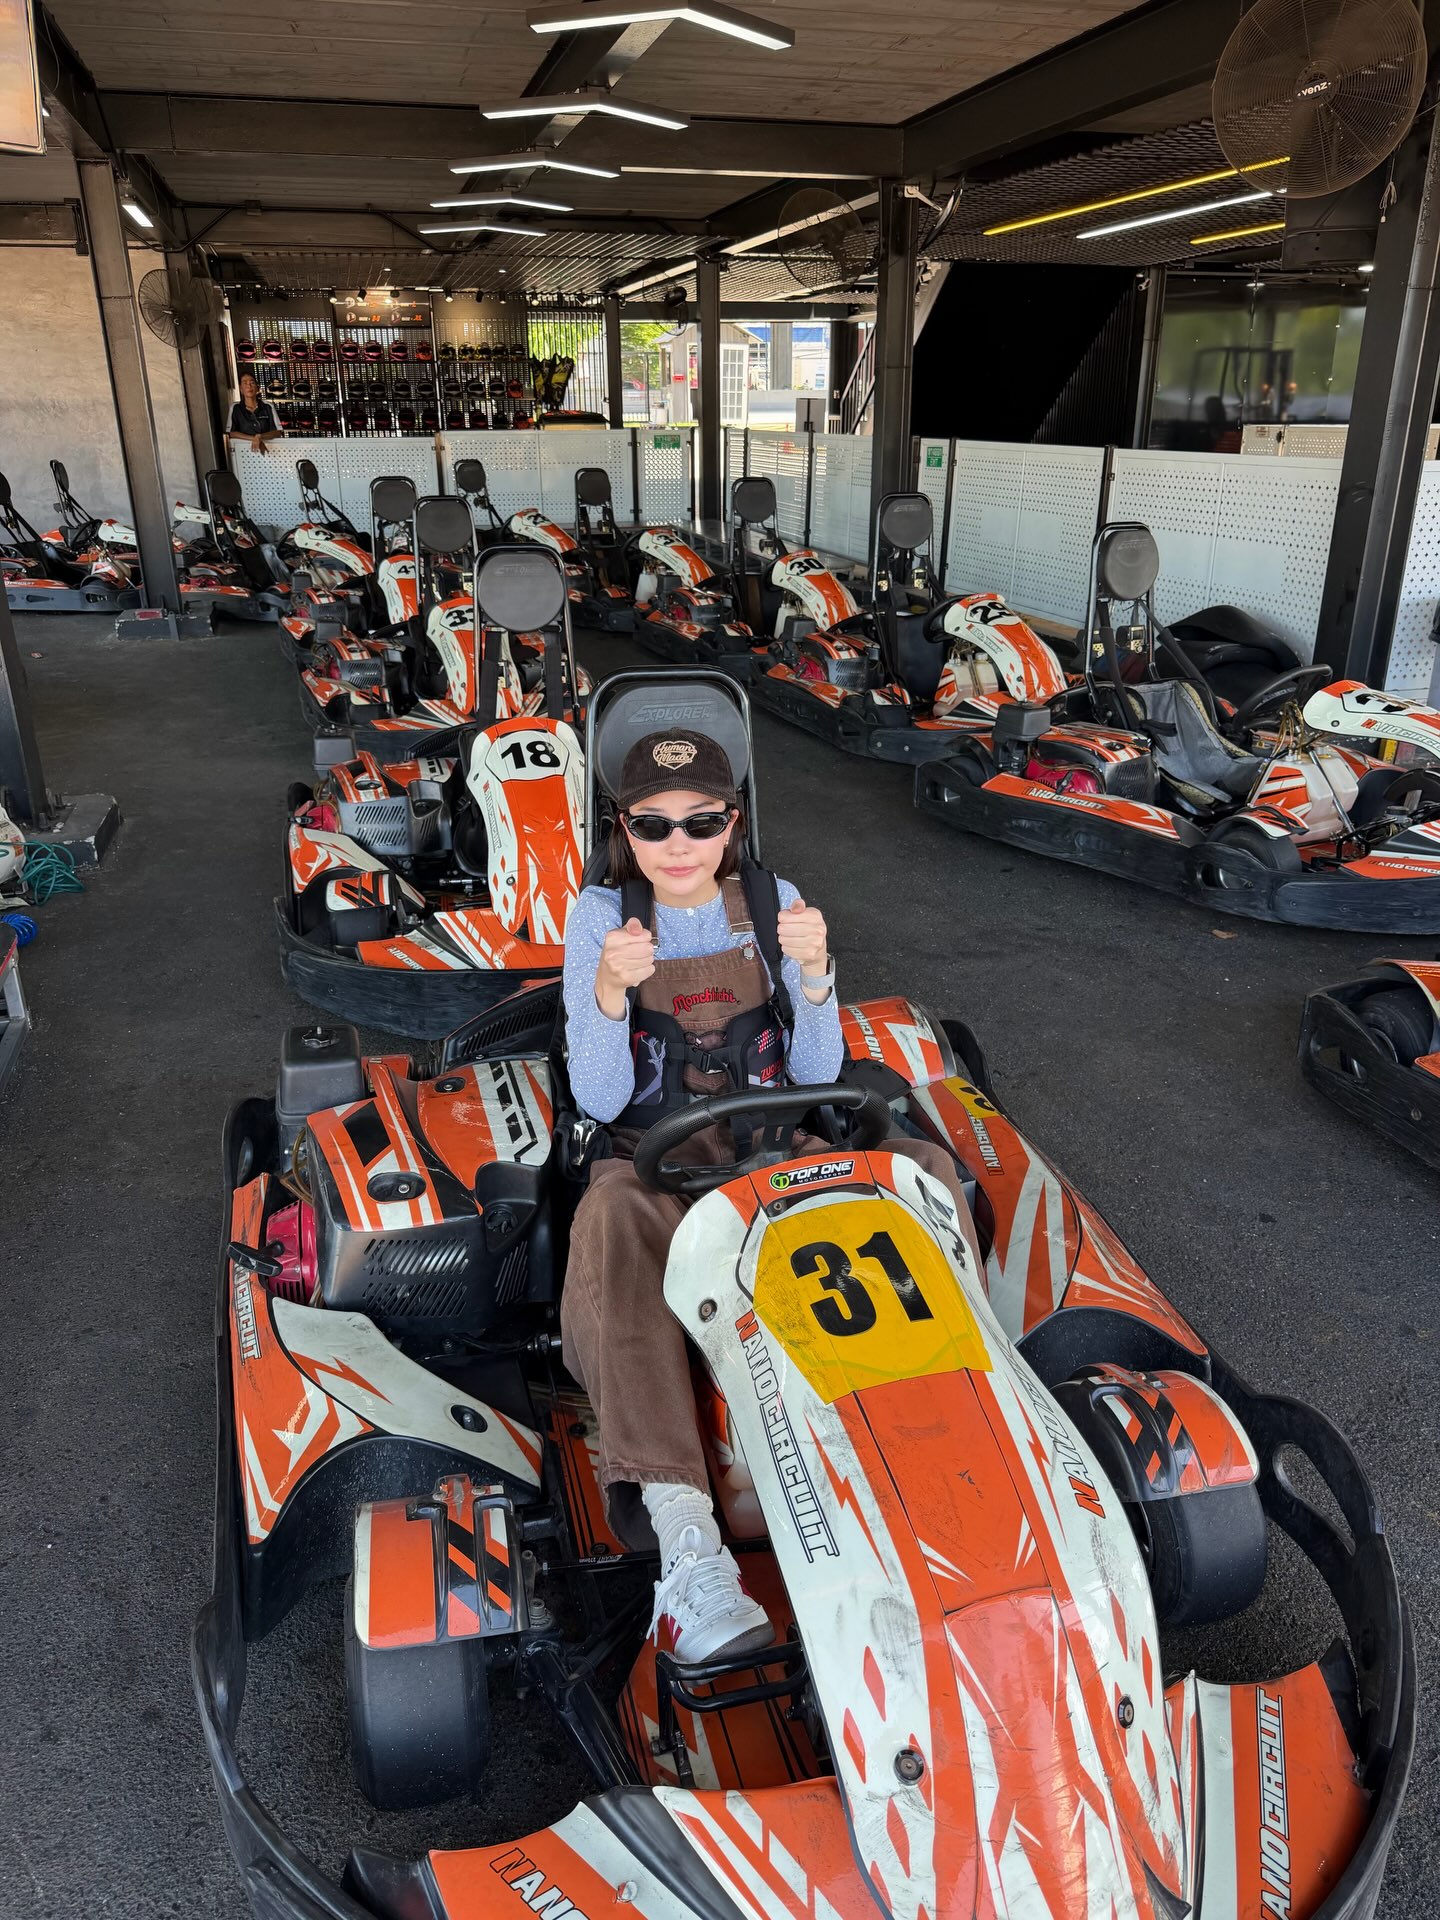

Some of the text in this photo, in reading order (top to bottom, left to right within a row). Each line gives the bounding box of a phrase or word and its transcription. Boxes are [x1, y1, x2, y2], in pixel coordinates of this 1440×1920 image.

[1301, 82, 1328, 96] venz
[789, 558, 825, 576] 30
[628, 701, 716, 725] EXPLORER
[500, 740, 561, 770] 18
[788, 1162, 853, 1181] TOP ONE
[799, 1171, 846, 1184] MOTORSPORT
[790, 1231, 934, 1337] 31
